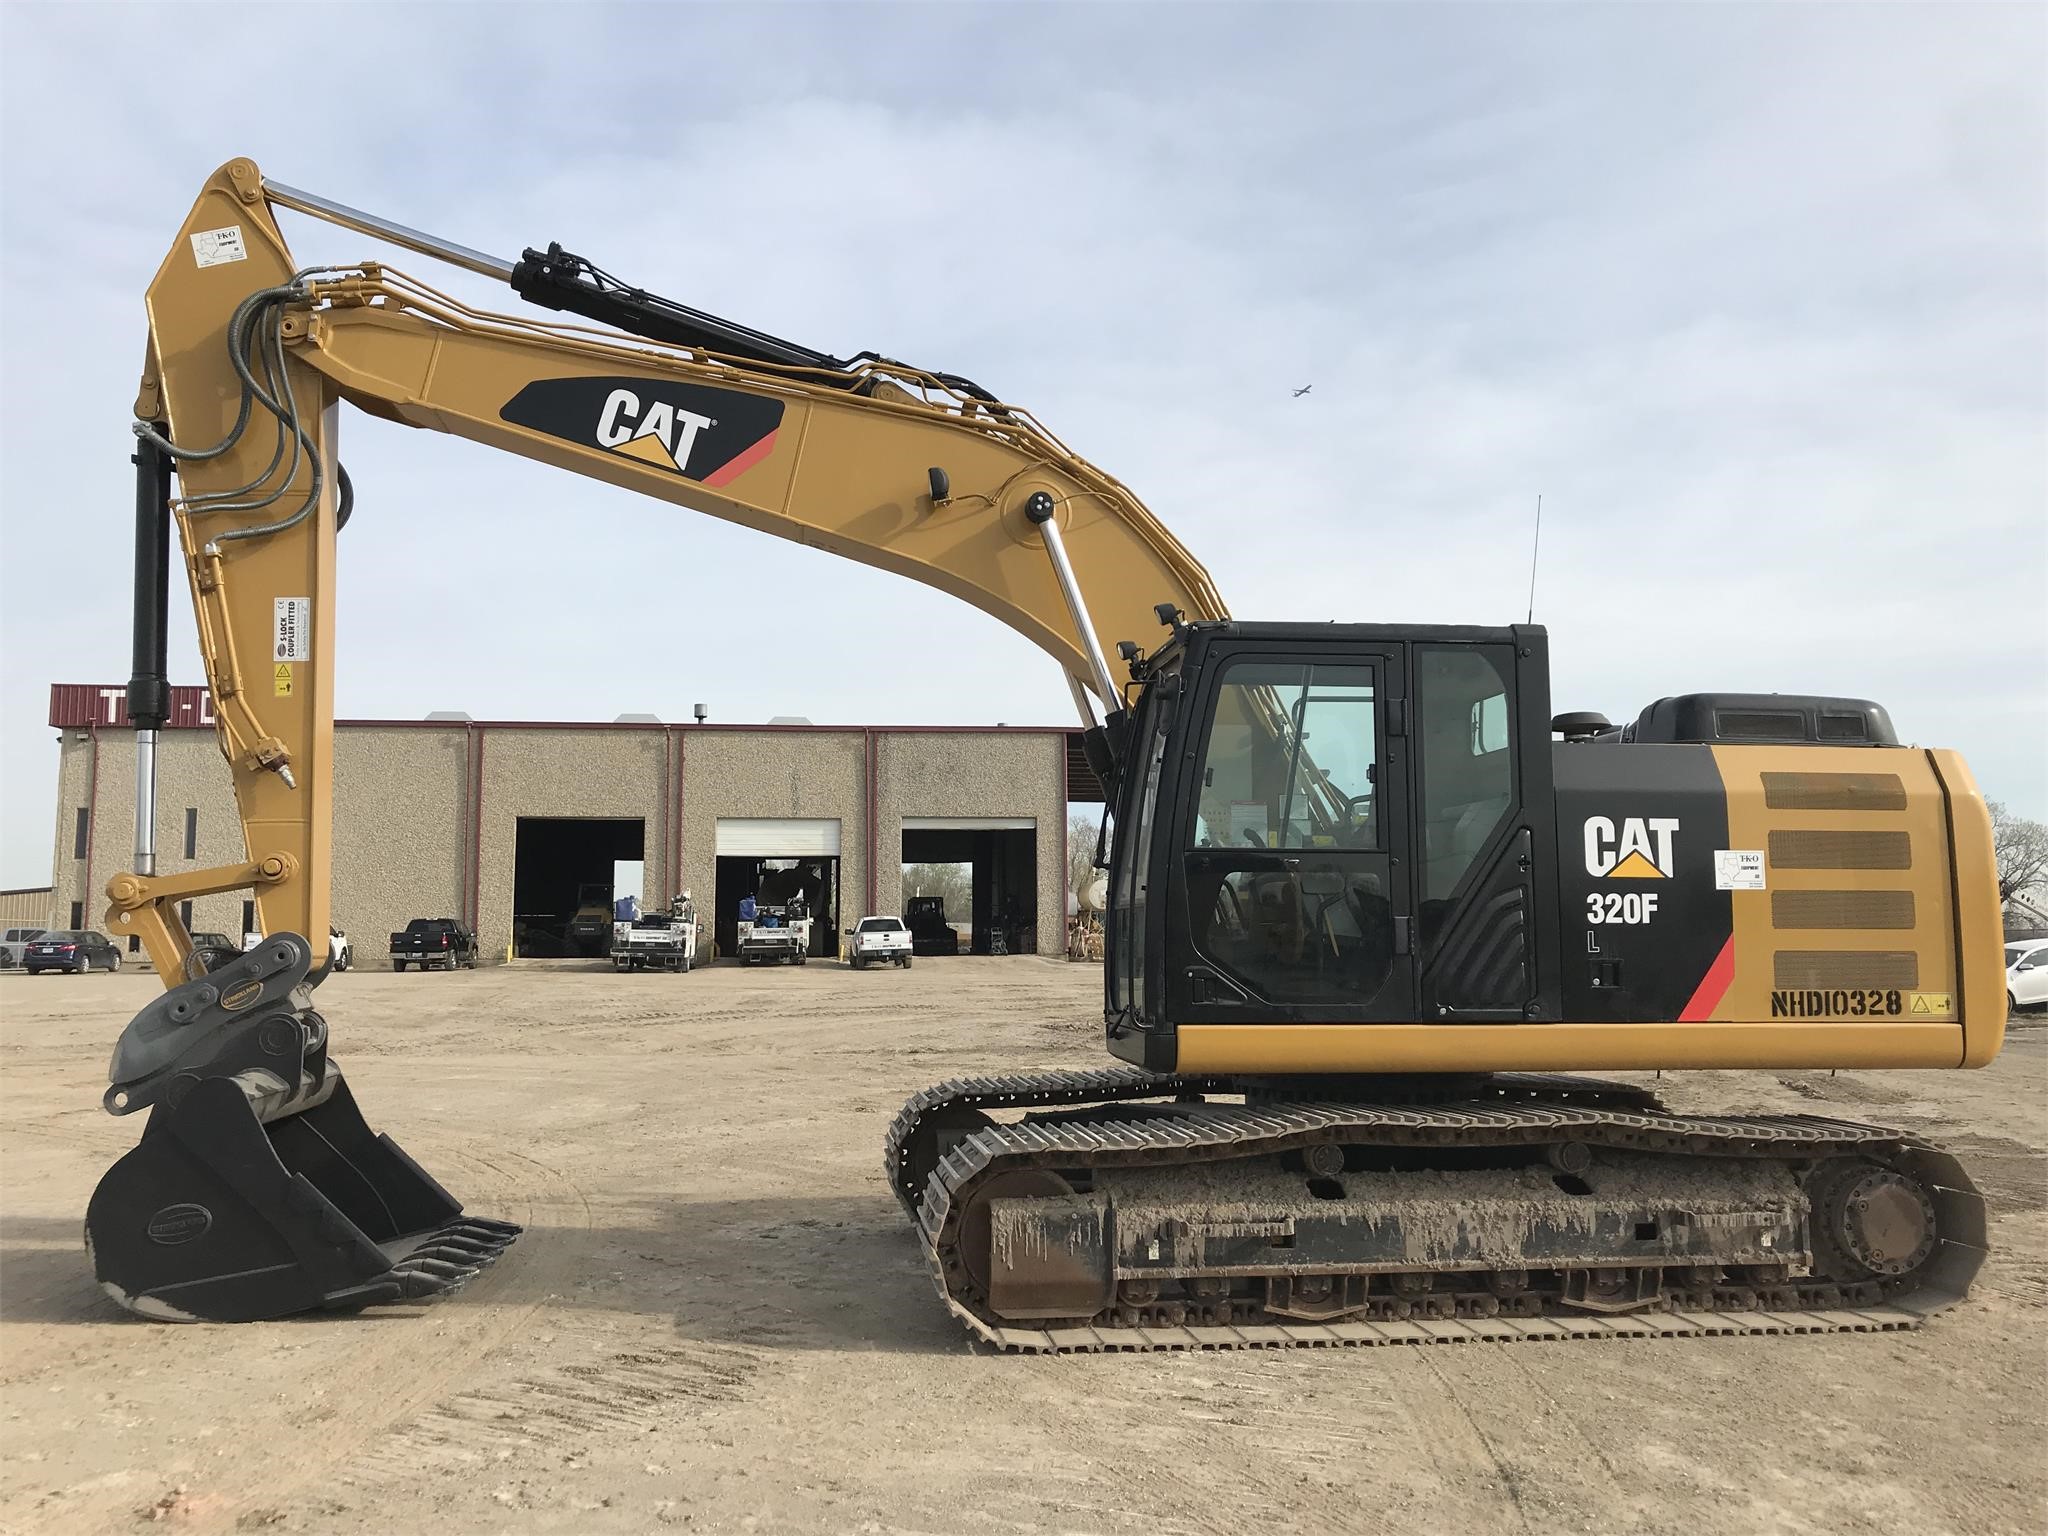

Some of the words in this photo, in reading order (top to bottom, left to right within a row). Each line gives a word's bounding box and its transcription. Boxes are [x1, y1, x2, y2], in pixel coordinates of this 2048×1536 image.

[596, 388, 712, 471] CAT
[287, 601, 295, 625] FITTED
[287, 626, 295, 657] COUPLER
[1584, 816, 1680, 878] CAT
[1586, 893, 1658, 924] 320F
[1587, 930, 1600, 953] L
